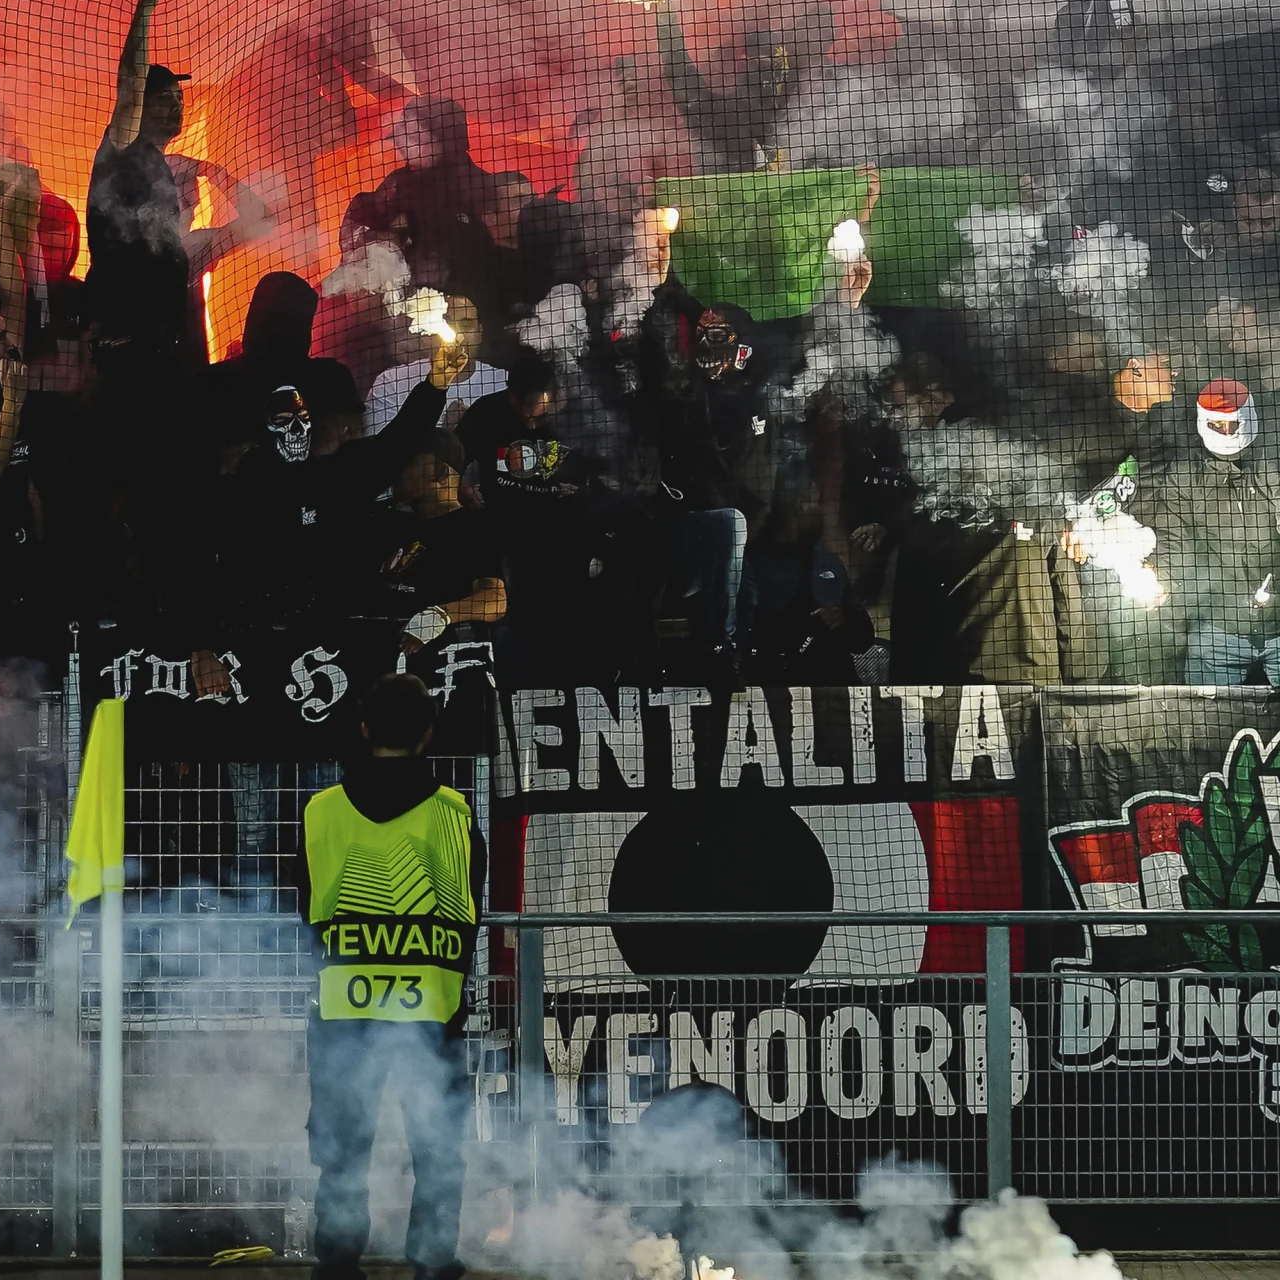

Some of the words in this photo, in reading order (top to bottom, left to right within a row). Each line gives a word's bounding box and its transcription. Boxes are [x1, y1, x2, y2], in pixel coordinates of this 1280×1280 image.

[492, 684, 1018, 798] ENTALITA
[347, 974, 423, 1009] 073
[476, 1003, 1030, 1141] FYENOORD
